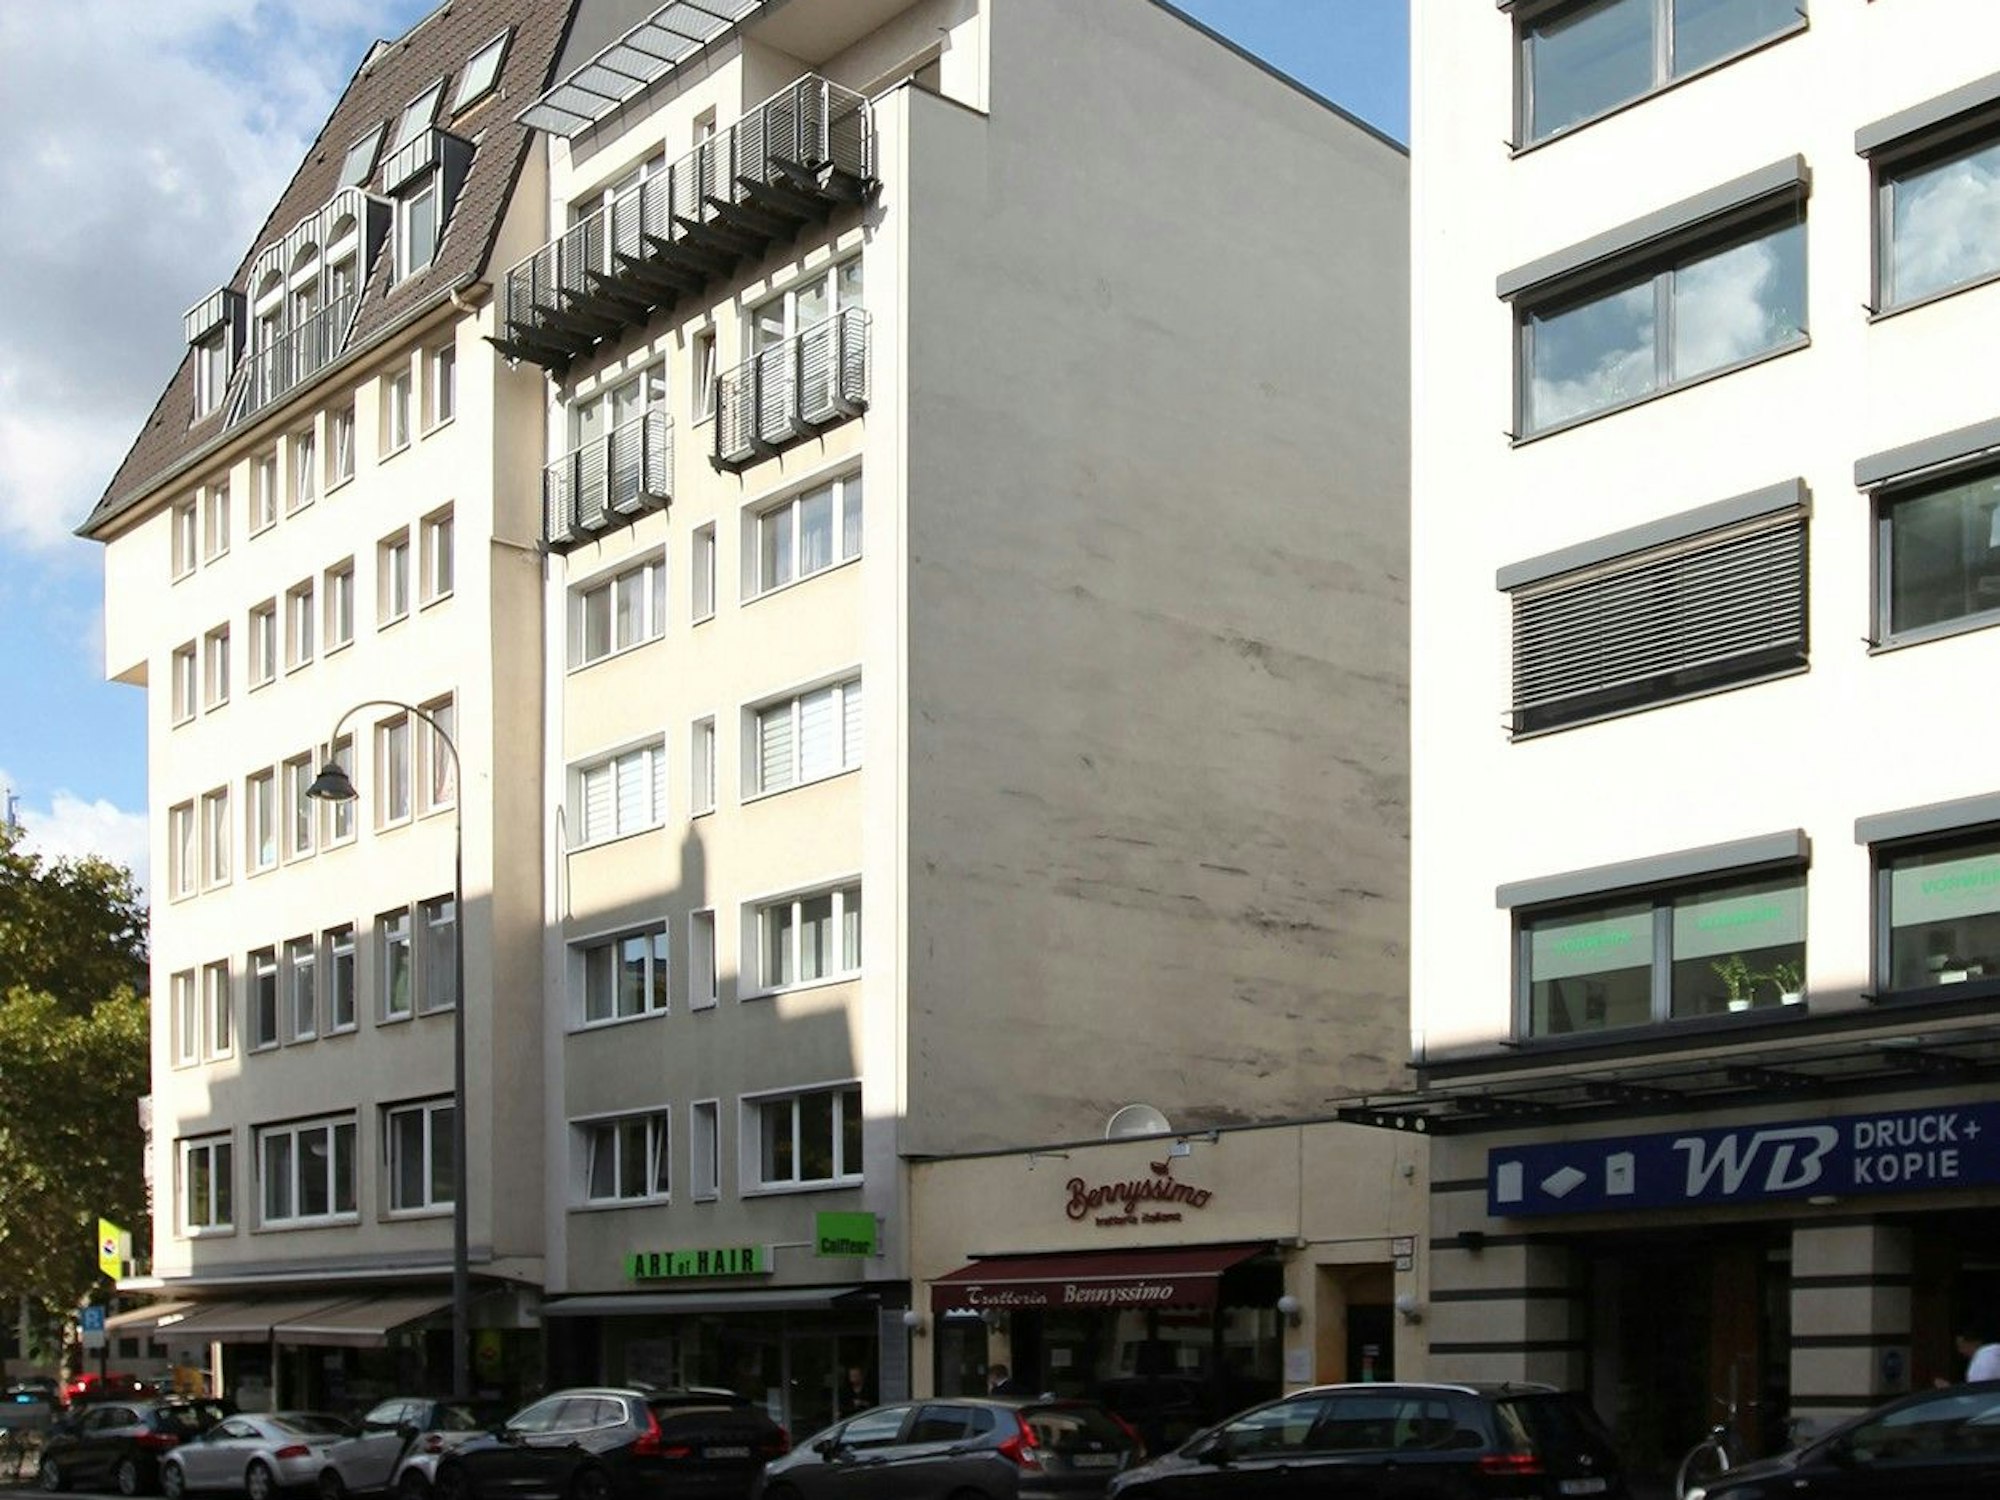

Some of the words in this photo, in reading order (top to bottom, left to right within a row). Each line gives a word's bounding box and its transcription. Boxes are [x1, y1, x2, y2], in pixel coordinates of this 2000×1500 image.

[1673, 1125, 1840, 1198] WB
[1854, 1149, 1960, 1184] KOPIE
[1065, 1176, 1214, 1221] Bennyssimo
[820, 1236, 871, 1255] Coiffeur
[635, 1252, 673, 1278] ART
[696, 1248, 754, 1275] HAIR
[966, 1286, 1048, 1306] Trattoria
[1063, 1281, 1176, 1306] Bennyssimo
